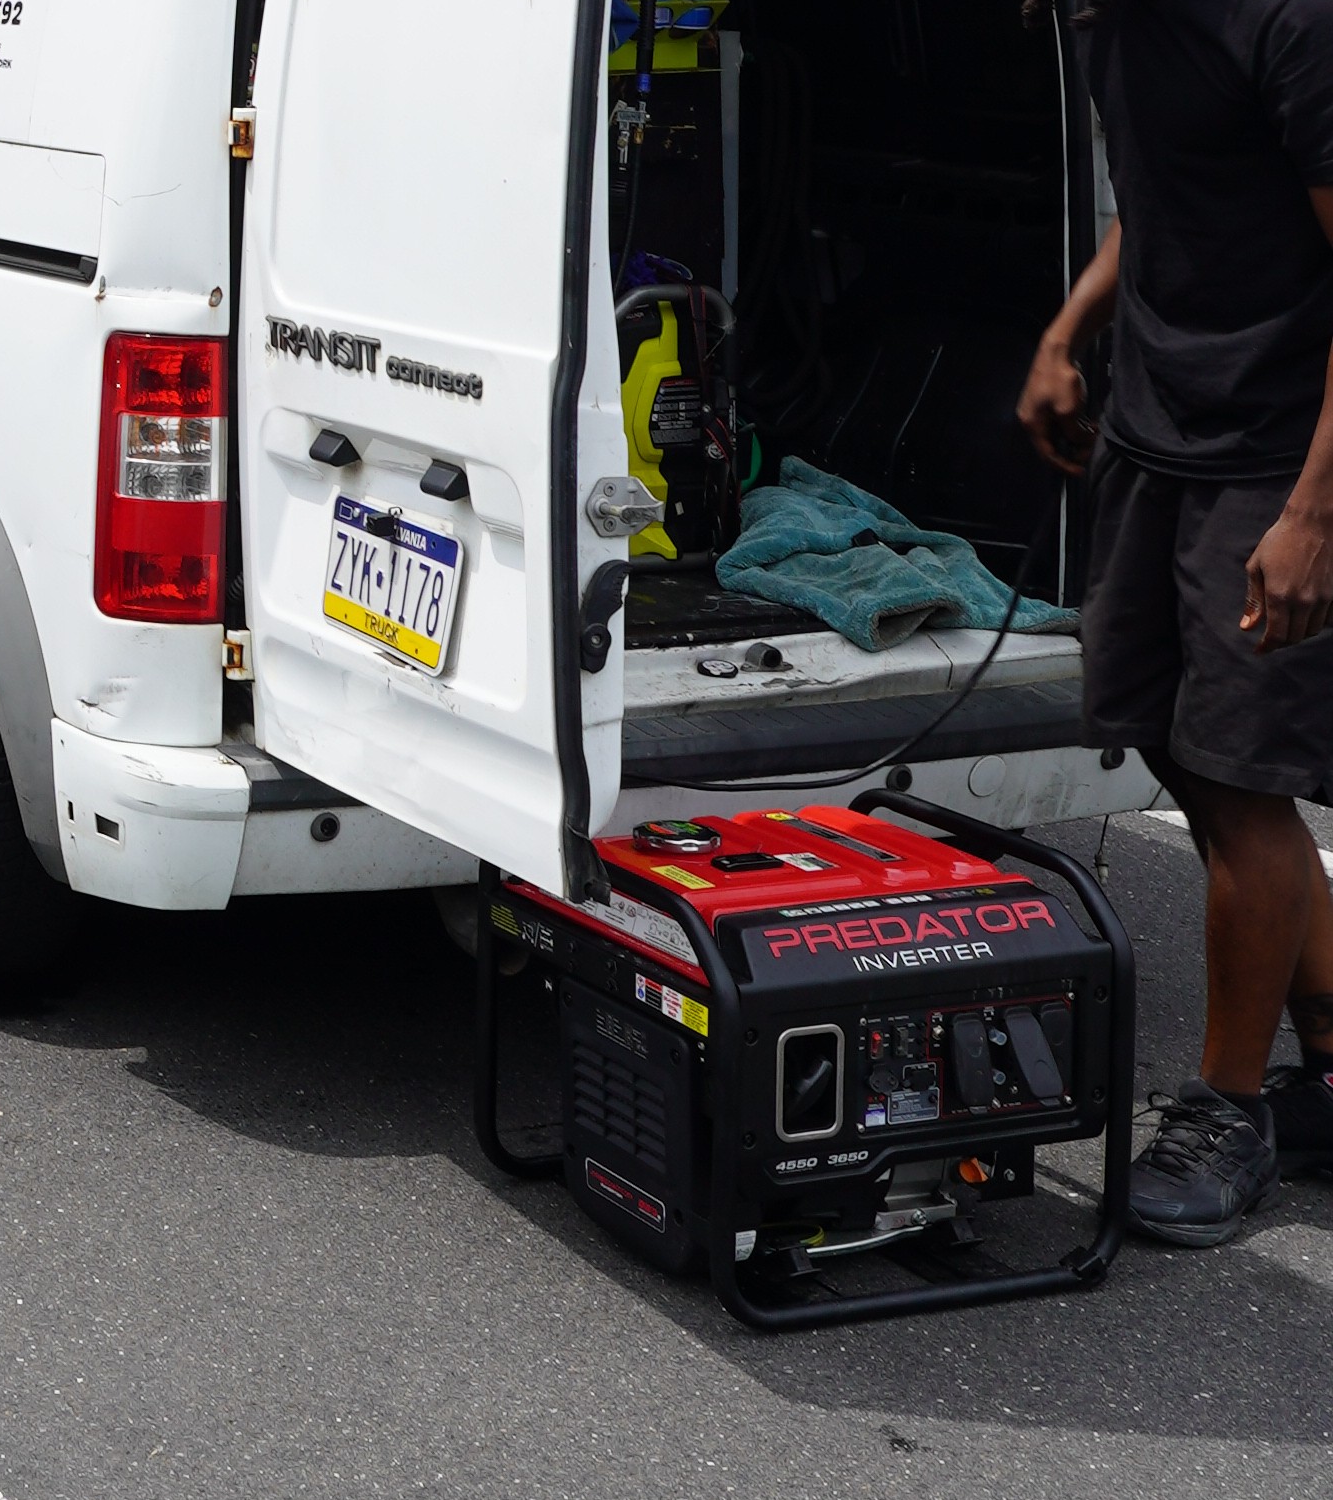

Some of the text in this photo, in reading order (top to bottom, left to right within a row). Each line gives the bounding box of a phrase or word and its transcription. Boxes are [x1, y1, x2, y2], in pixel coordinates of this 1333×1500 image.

[265, 315, 483, 400] TRANSIT connect
[363, 610, 401, 644] TRUCK
[763, 900, 1056, 959] PREDATOR
[852, 941, 995, 973] INVERTER
[775, 1157, 818, 1171] 4550
[827, 1150, 869, 1165] 3650
